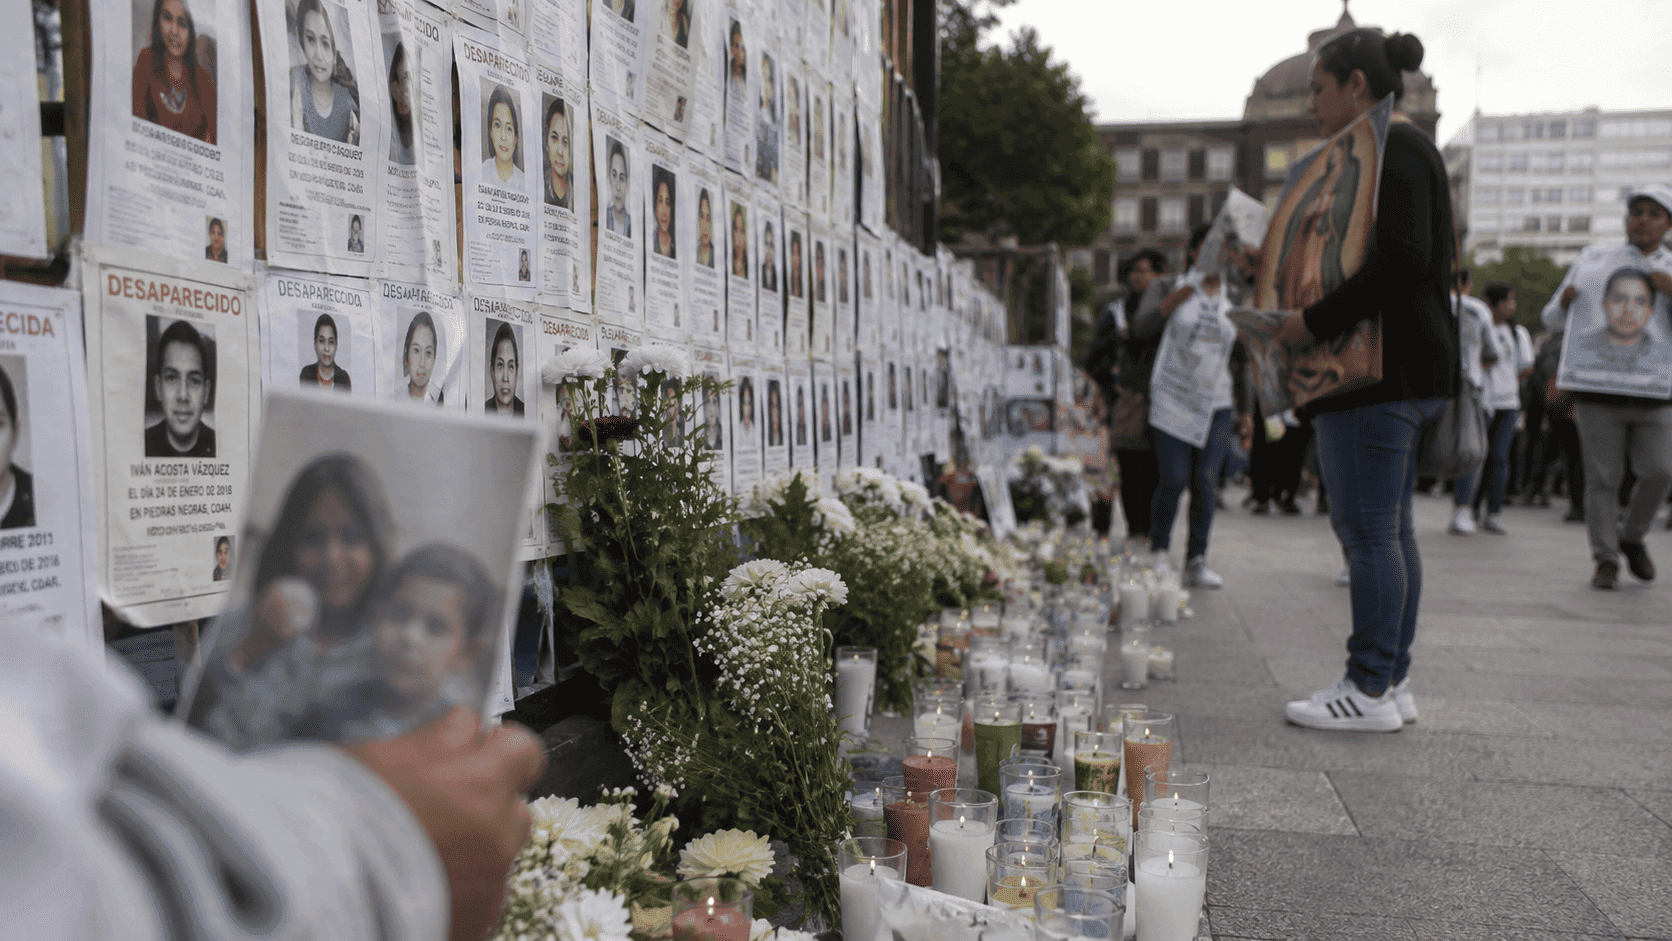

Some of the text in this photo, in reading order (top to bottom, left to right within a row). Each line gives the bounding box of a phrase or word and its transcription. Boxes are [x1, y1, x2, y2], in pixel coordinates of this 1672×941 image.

[108, 274, 241, 316] DESAPARECIDO
[130, 461, 230, 478] IVÁN ACOSTA VÁZQUEZ
[128, 487, 138, 499] EL
[156, 487, 165, 498] 24
[167, 486, 178, 498] DE
[179, 486, 204, 497] ENERO
[130, 507, 141, 520] EN
[143, 505, 176, 518] PIEDRAS
